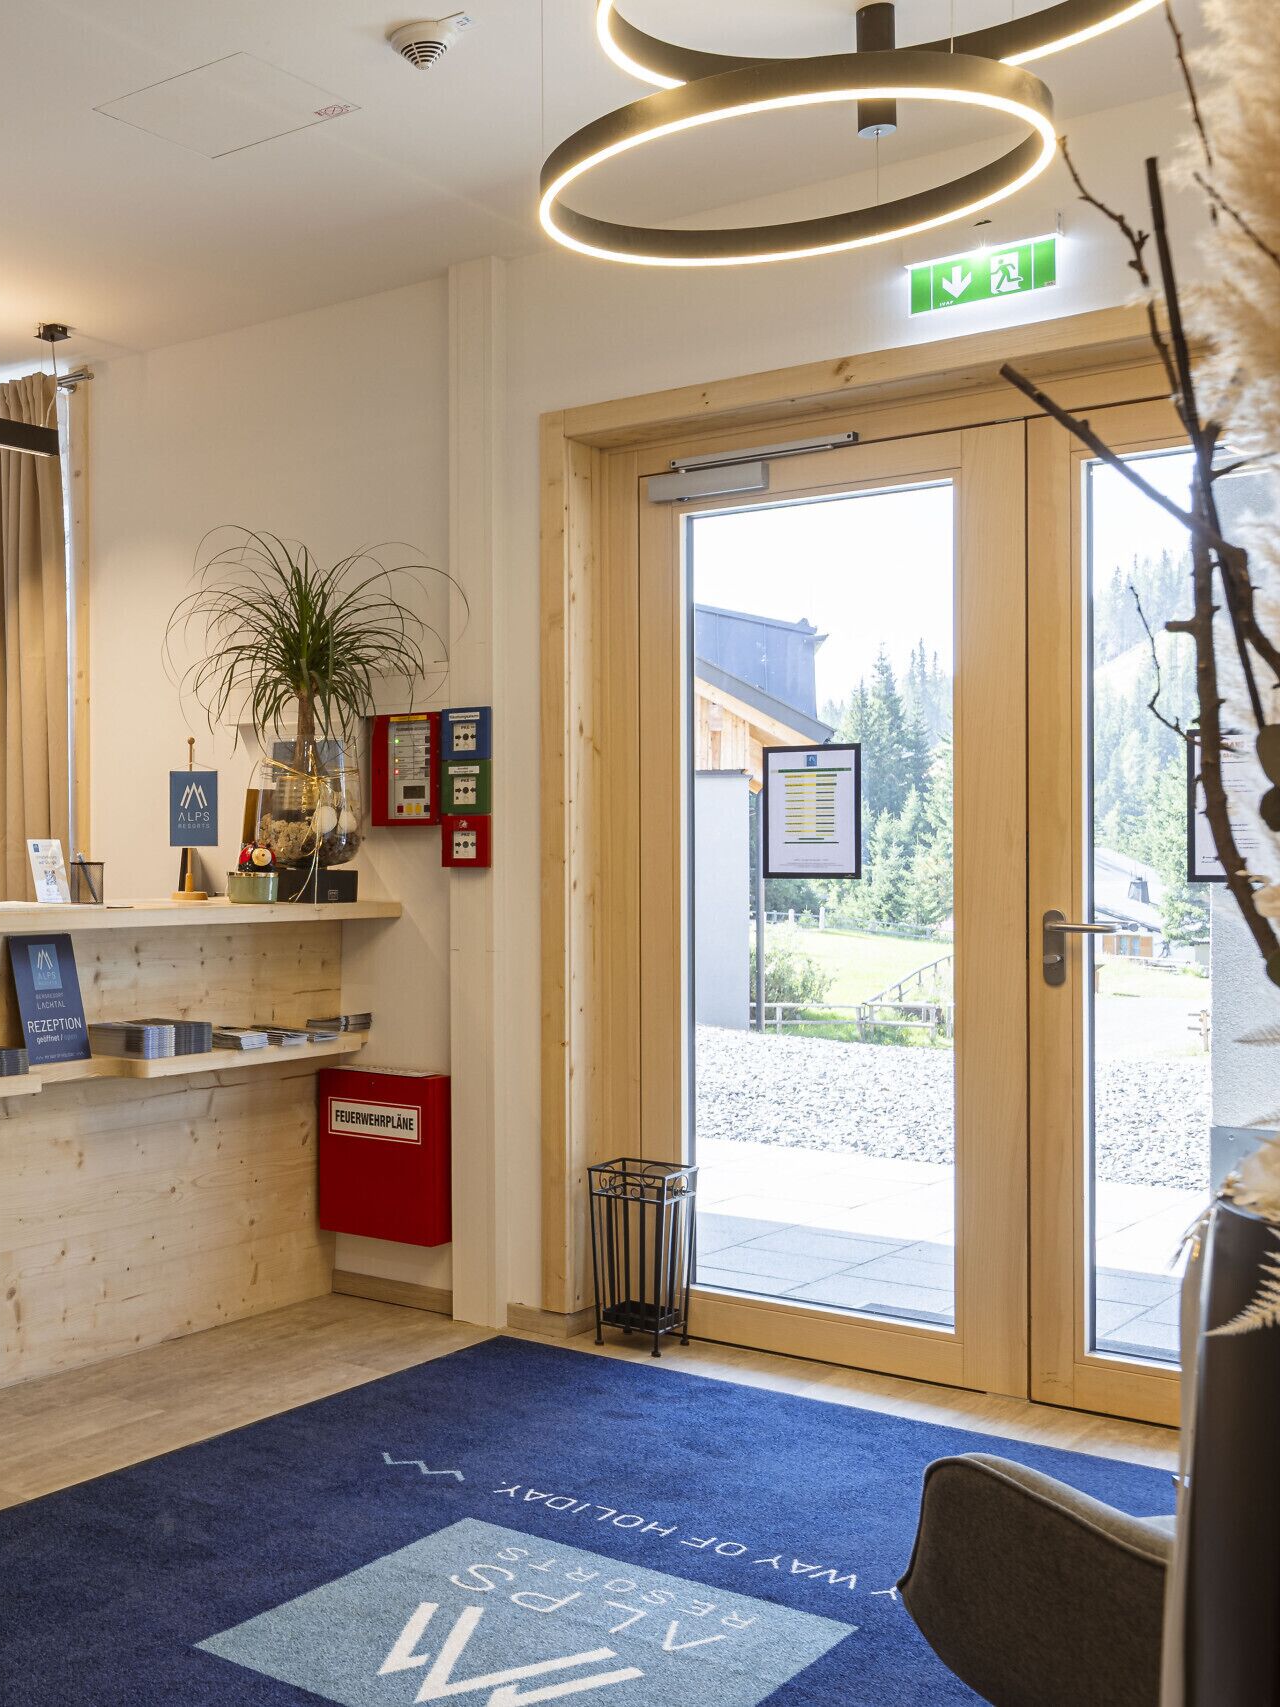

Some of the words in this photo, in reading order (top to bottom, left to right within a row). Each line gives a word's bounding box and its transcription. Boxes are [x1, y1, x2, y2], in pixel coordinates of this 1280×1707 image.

[178, 811, 210, 822] ALPS
[37, 1000, 66, 1010] LACHTAL
[27, 1017, 82, 1033] REZEPTION
[36, 1035, 60, 1045] geöffnet
[335, 1109, 414, 1131] FEUERWEHRPLÄNE
[680, 1537, 748, 1556] OF
[751, 1555, 857, 1590] WAY
[496, 1547, 759, 1630] RESORTS
[870, 1586, 898, 1600] Y
[449, 1563, 727, 1651] ALPS
